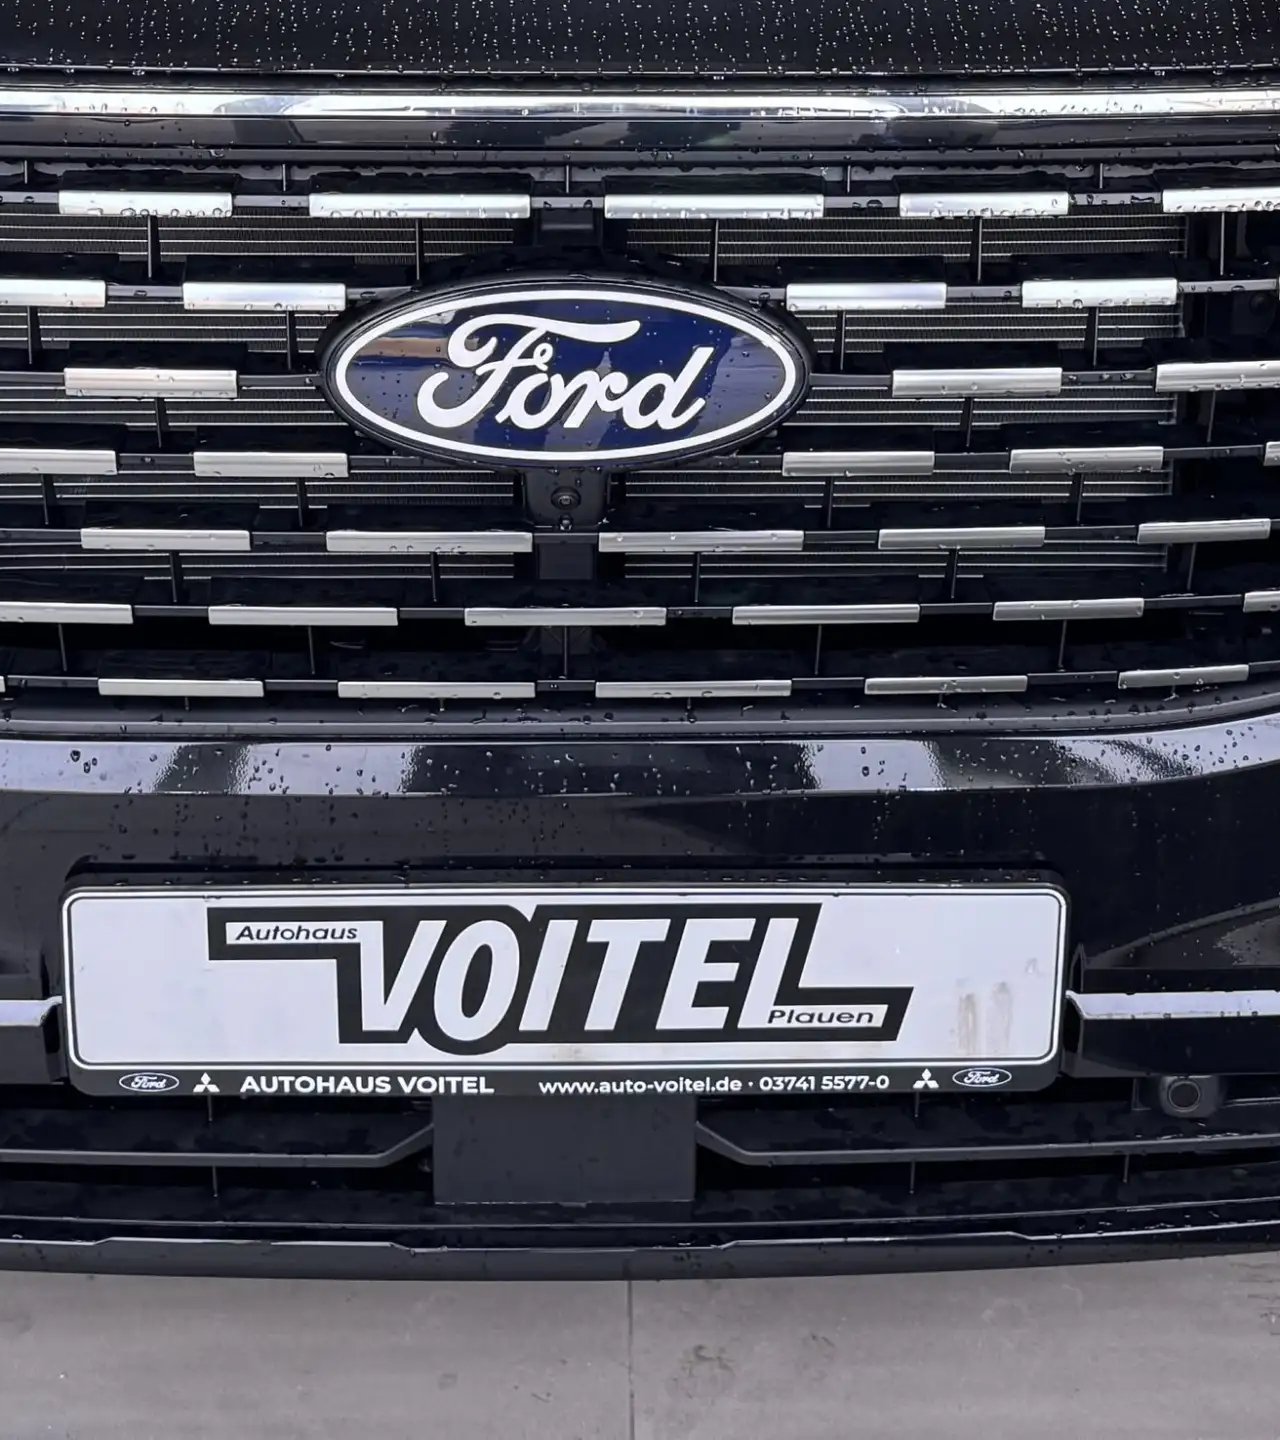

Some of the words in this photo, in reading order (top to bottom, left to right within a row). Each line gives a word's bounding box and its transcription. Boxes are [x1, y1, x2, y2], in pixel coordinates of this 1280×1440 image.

[416, 313, 715, 430] Ford
[235, 924, 358, 942] Autohaus
[361, 918, 888, 1041] VOITEL
[767, 1008, 874, 1024] Plauen
[240, 1075, 392, 1094] AUTOHAUS
[398, 1075, 495, 1094] VOITEL
[538, 1075, 742, 1095] www.auto-voitel.de
[759, 1076, 815, 1092] 03741
[821, 1074, 890, 1091] 5577-0
